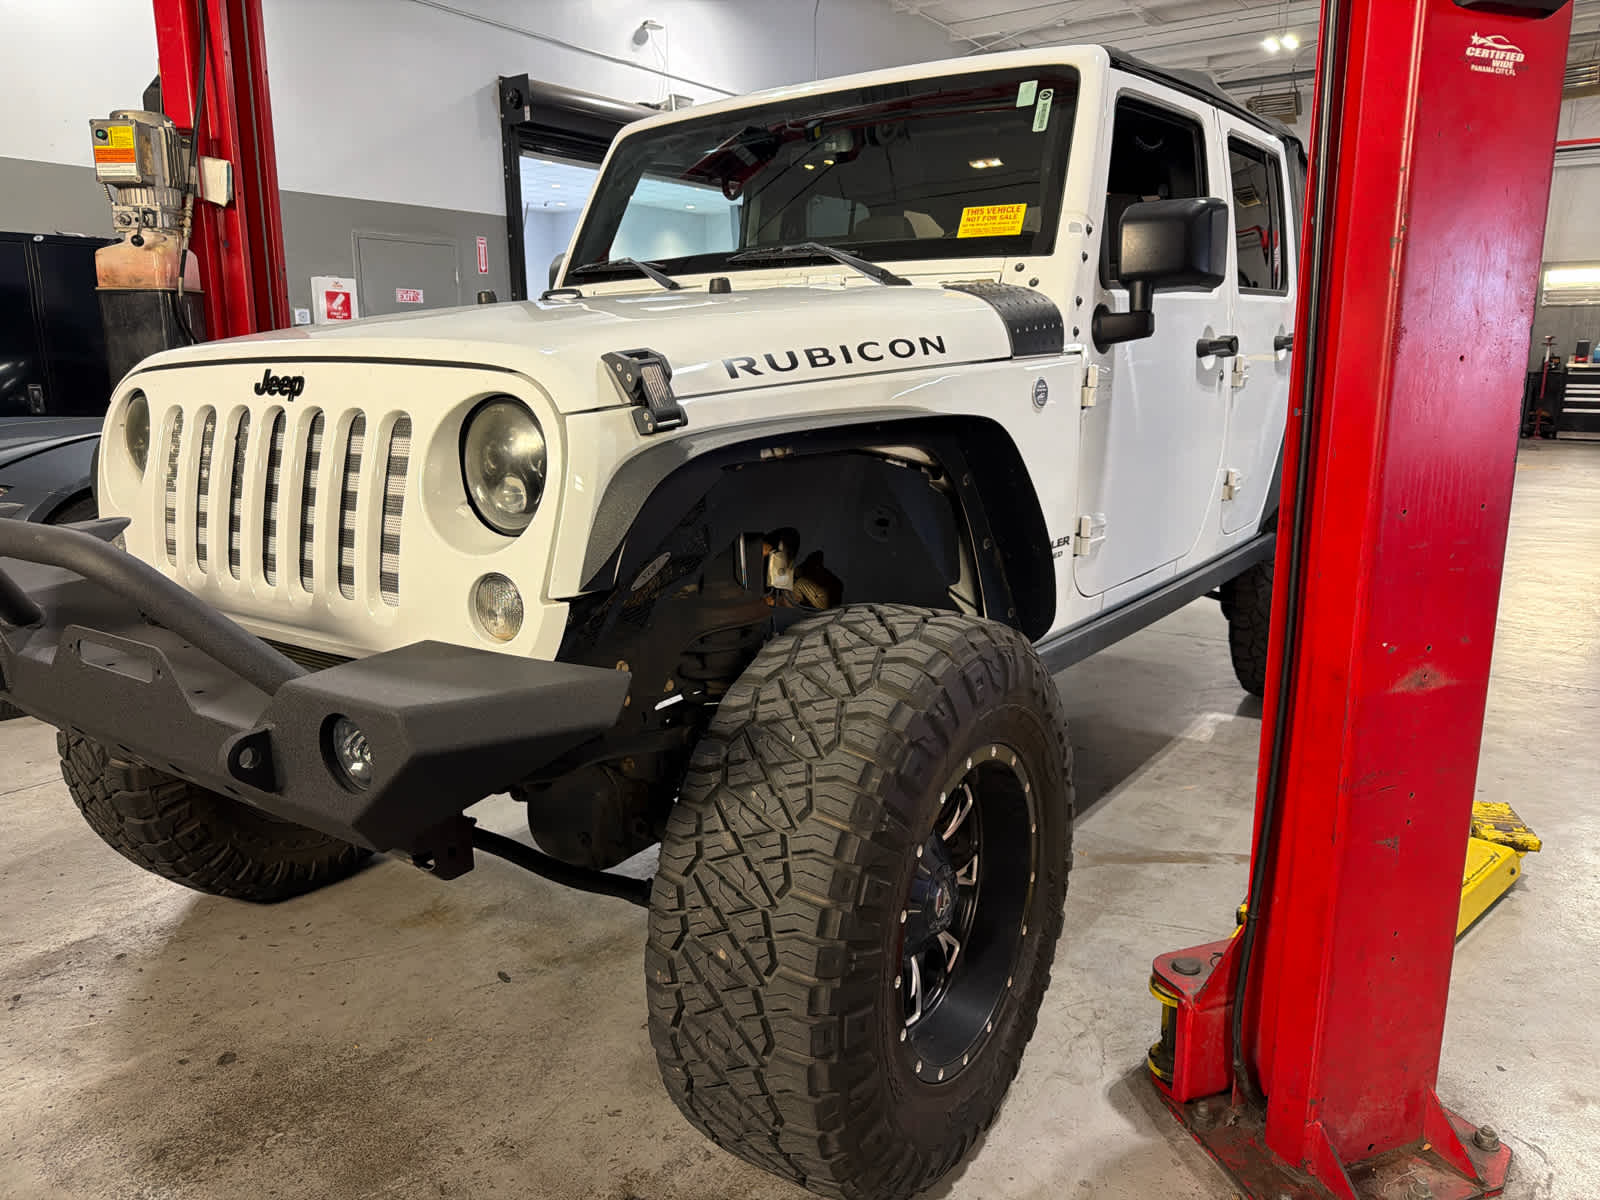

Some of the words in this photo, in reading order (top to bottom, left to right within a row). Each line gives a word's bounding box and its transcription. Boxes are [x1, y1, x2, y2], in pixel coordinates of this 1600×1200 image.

[1465, 47, 1525, 63] CERTIFIED
[1470, 64, 1495, 73] PANAMA
[1491, 60, 1514, 69] WIDE
[967, 208, 984, 216] THIS
[987, 206, 1022, 214] VEHICLE
[722, 335, 947, 379] RUBICON
[254, 368, 305, 402] Jeep
